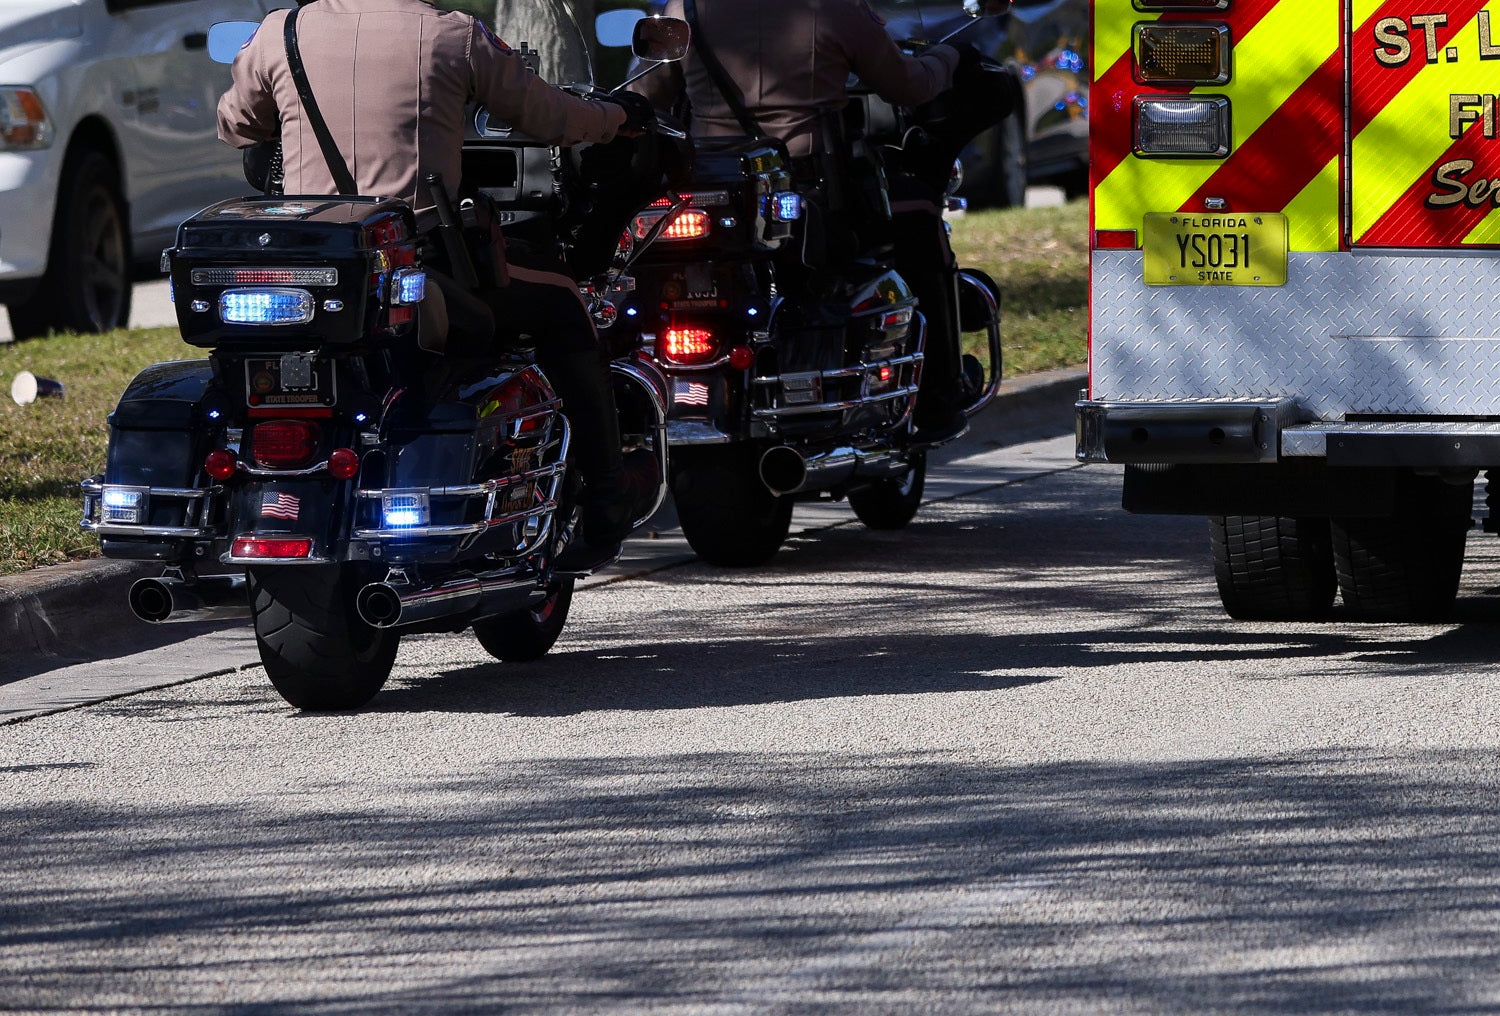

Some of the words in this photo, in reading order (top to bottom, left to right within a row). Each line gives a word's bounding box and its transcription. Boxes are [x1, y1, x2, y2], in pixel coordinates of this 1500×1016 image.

[1373, 13, 1458, 67] ST.
[1182, 218, 1247, 228] FLORIDA
[1176, 234, 1249, 268] YS031
[1198, 271, 1233, 281] STATE
[265, 395, 286, 403] STATE
[287, 395, 318, 403] TROOPER
